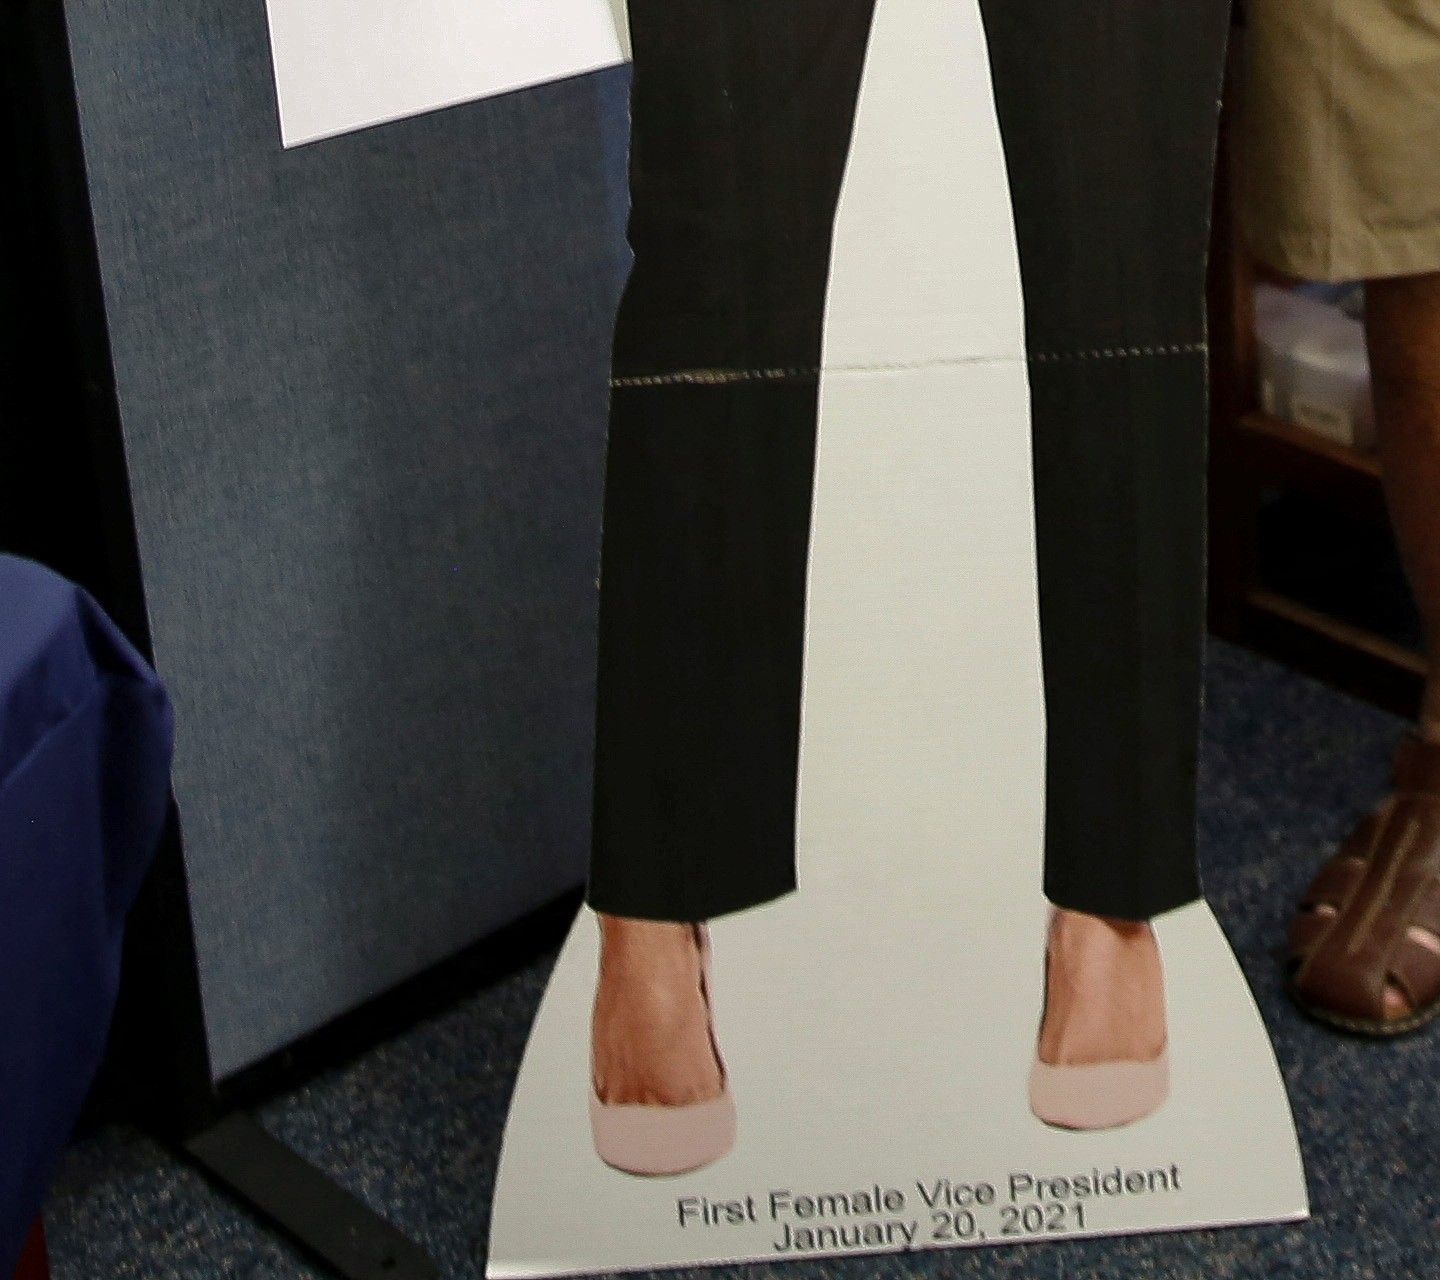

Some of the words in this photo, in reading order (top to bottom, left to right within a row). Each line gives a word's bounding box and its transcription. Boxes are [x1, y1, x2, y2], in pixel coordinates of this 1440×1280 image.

[677, 1194, 757, 1228] First
[768, 1184, 906, 1220] Female
[915, 1178, 997, 1208] Vice
[1009, 1162, 1182, 1203] President
[773, 1217, 918, 1252] January
[931, 1208, 989, 1241] 20,
[999, 1201, 1088, 1236] 2021
